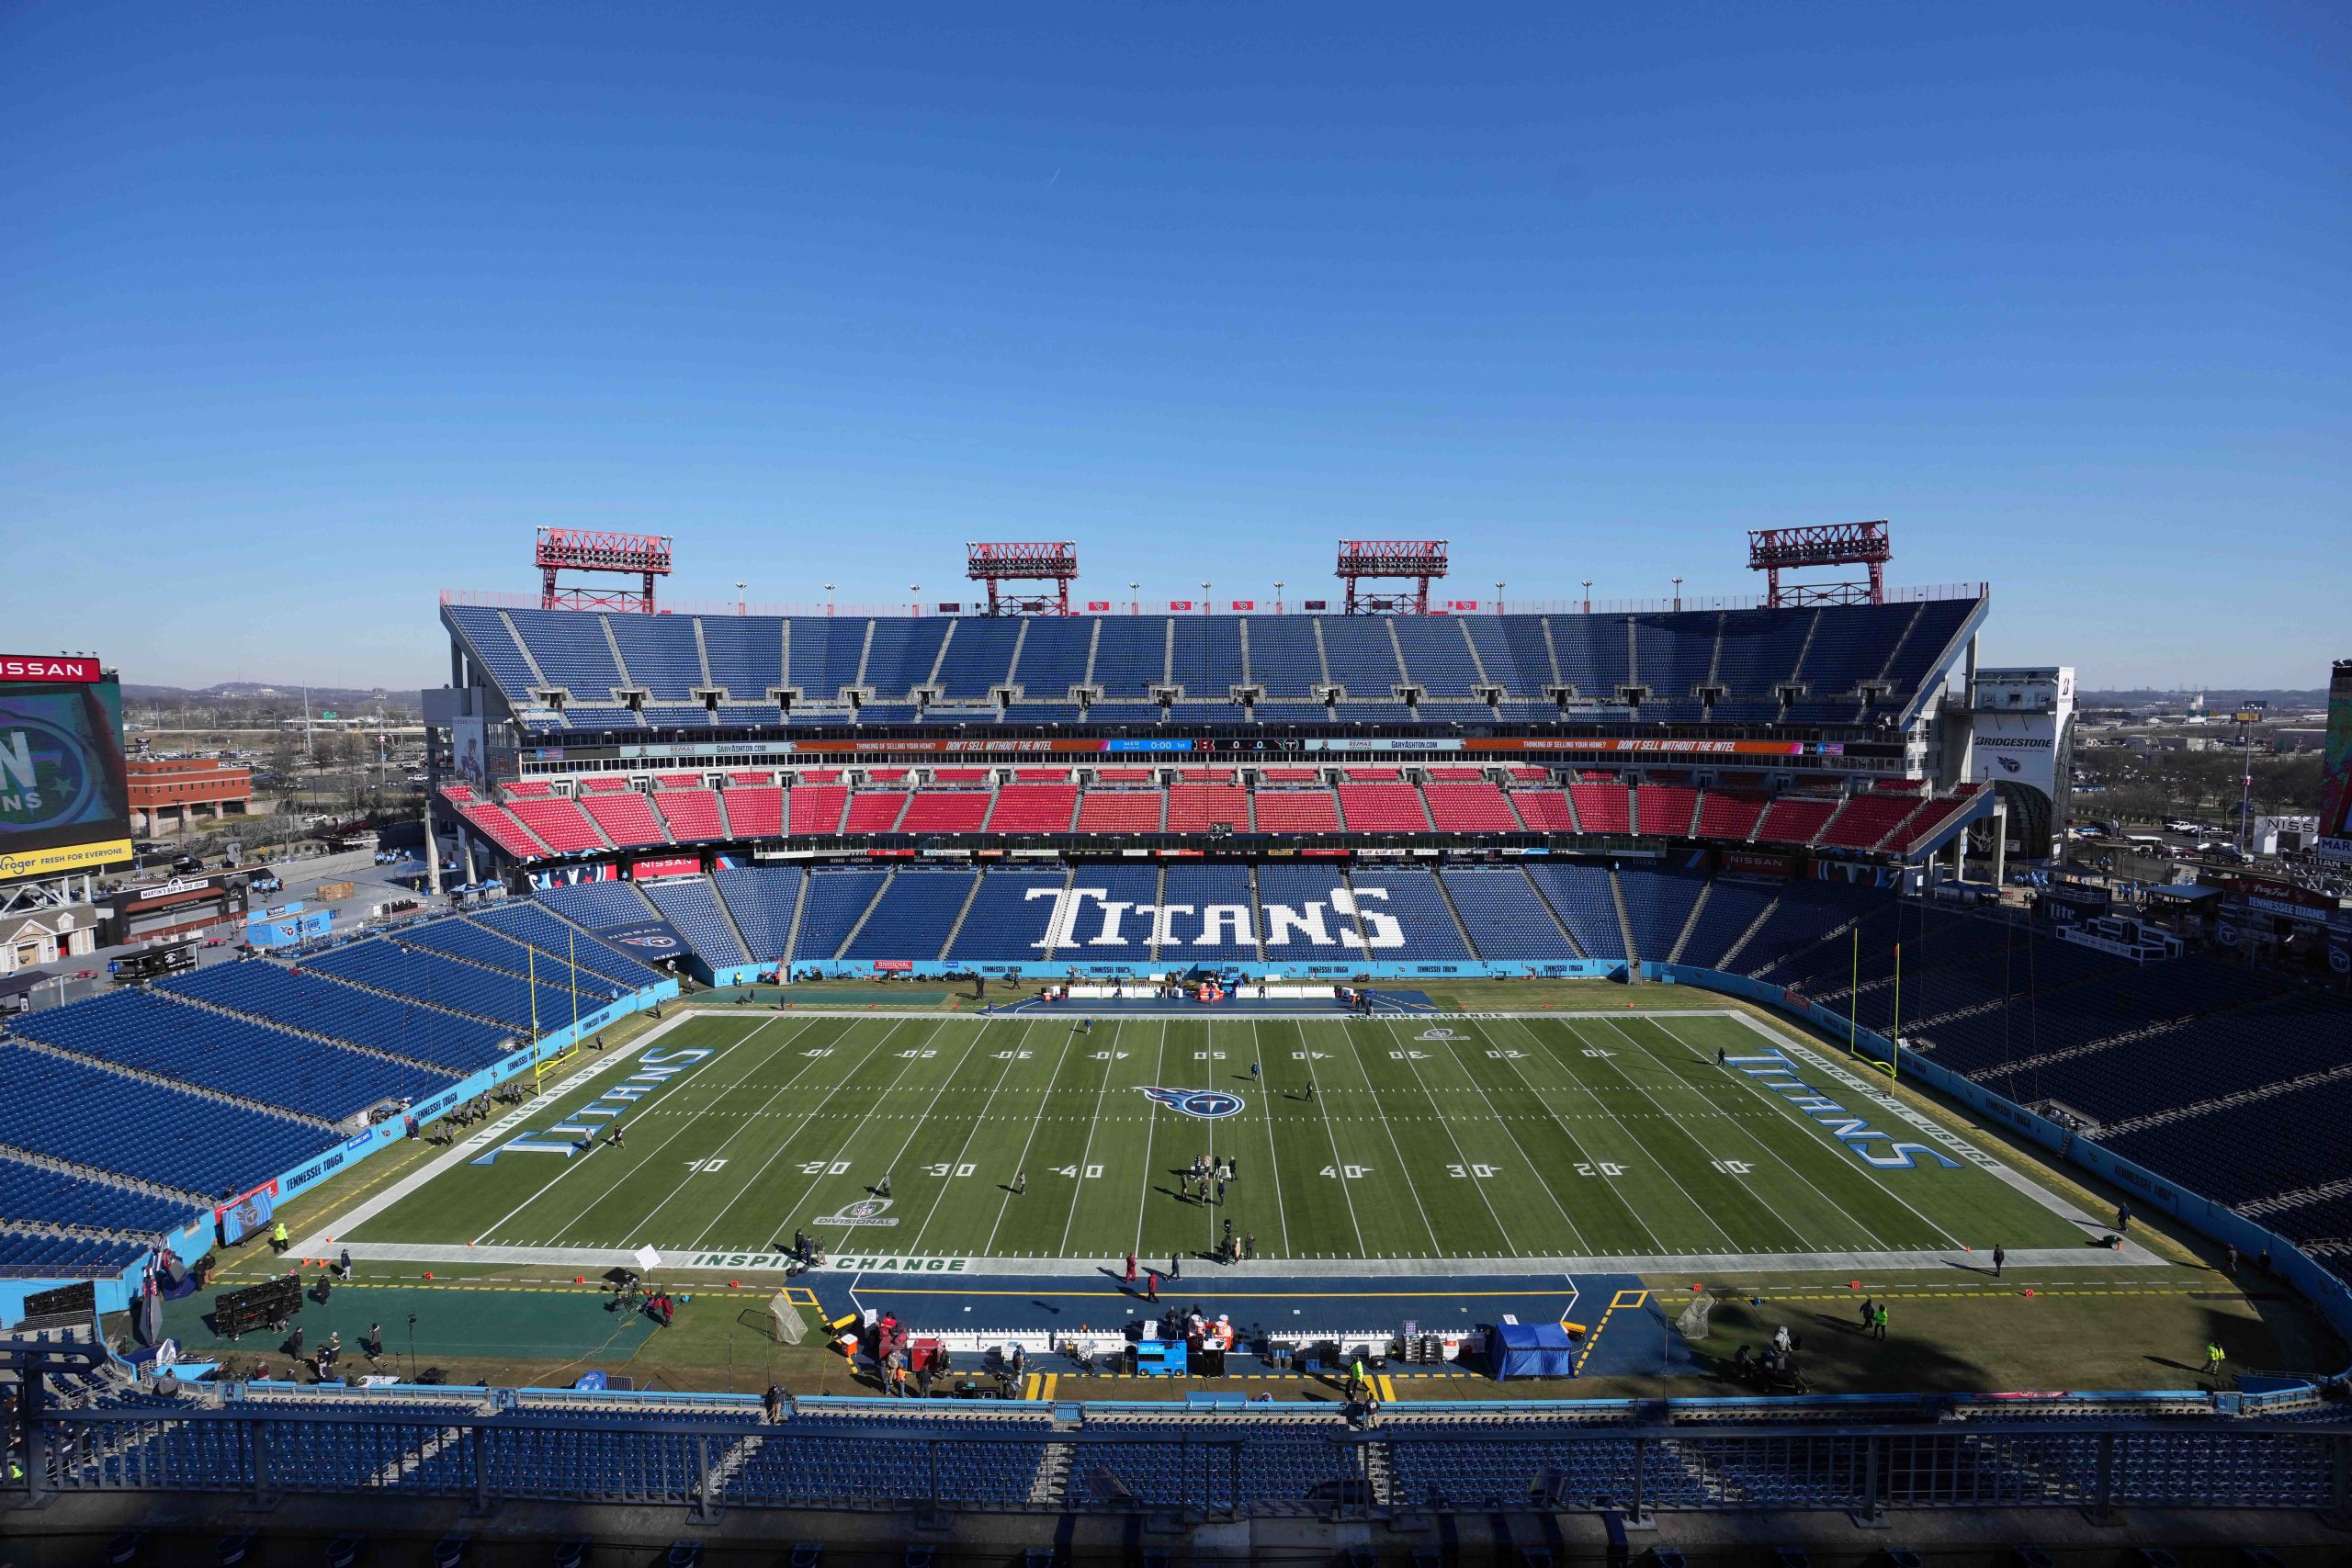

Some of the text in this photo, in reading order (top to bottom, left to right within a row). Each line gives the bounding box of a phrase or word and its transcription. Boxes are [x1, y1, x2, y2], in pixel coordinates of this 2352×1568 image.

[856, 742, 879, 750] THINKING
[879, 742, 886, 750] OF
[887, 742, 905, 750] SELLING
[945, 740, 1052, 750] DON'T SELL WITHOUT THE INTEL
[1151, 741, 1171, 750] 0:00
[1233, 740, 1239, 749] 0
[1257, 740, 1263, 749] 0
[1523, 740, 1546, 749] THINKING
[1546, 740, 1553, 749] OF
[1554, 740, 1574, 749] SELLING
[1617, 739, 1735, 752] DON'T SELL WITHOUT THE INTEL
[1974, 736, 2052, 748] BRIDGESTONE
[2322, 839, 2352, 852] MAR
[40, 855, 65, 865] FRESH
[68, 853, 84, 862] FOR
[640, 858, 692, 869] NISSAN
[1730, 855, 1782, 867] NISSAN
[142, 888, 166, 897] MARTIN'S
[2248, 896, 2326, 920] TENNESSEE TITANS
[1024, 887, 1406, 948] TITANS
[653, 951, 681, 961] NISSAN
[982, 965, 1006, 974] TENNESSEE
[902, 1050, 938, 1058] 20
[999, 1051, 1033, 1059] 30
[1096, 1052, 1129, 1060] 40
[1193, 1052, 1226, 1060] 50
[1389, 1051, 1424, 1059] 30
[1486, 1050, 1521, 1058] 20
[507, 1055, 528, 1072] TENNESSEE
[442, 1092, 458, 1110] TOUGH
[469, 1058, 618, 1145] IT TAKES ALL OF US
[469, 1047, 717, 1165] TITANS
[1792, 1047, 1858, 1082] ADVANCE
[1911, 1114, 2000, 1168] JUSTICE
[1724, 1047, 1964, 1169] TITANS
[286, 1163, 322, 1192] TENNESSEE
[322, 1151, 345, 1172] TOUGH
[689, 1158, 729, 1173] 10
[802, 1161, 852, 1175] 20
[929, 1163, 977, 1177] 30
[1058, 1165, 1104, 1179] 40
[1319, 1165, 1363, 1179] 40
[1446, 1164, 1494, 1178] 30
[1573, 1162, 1624, 1177] 20
[1710, 1159, 1750, 1175] 10
[691, 1254, 966, 1271] INSPIR CHANGE
